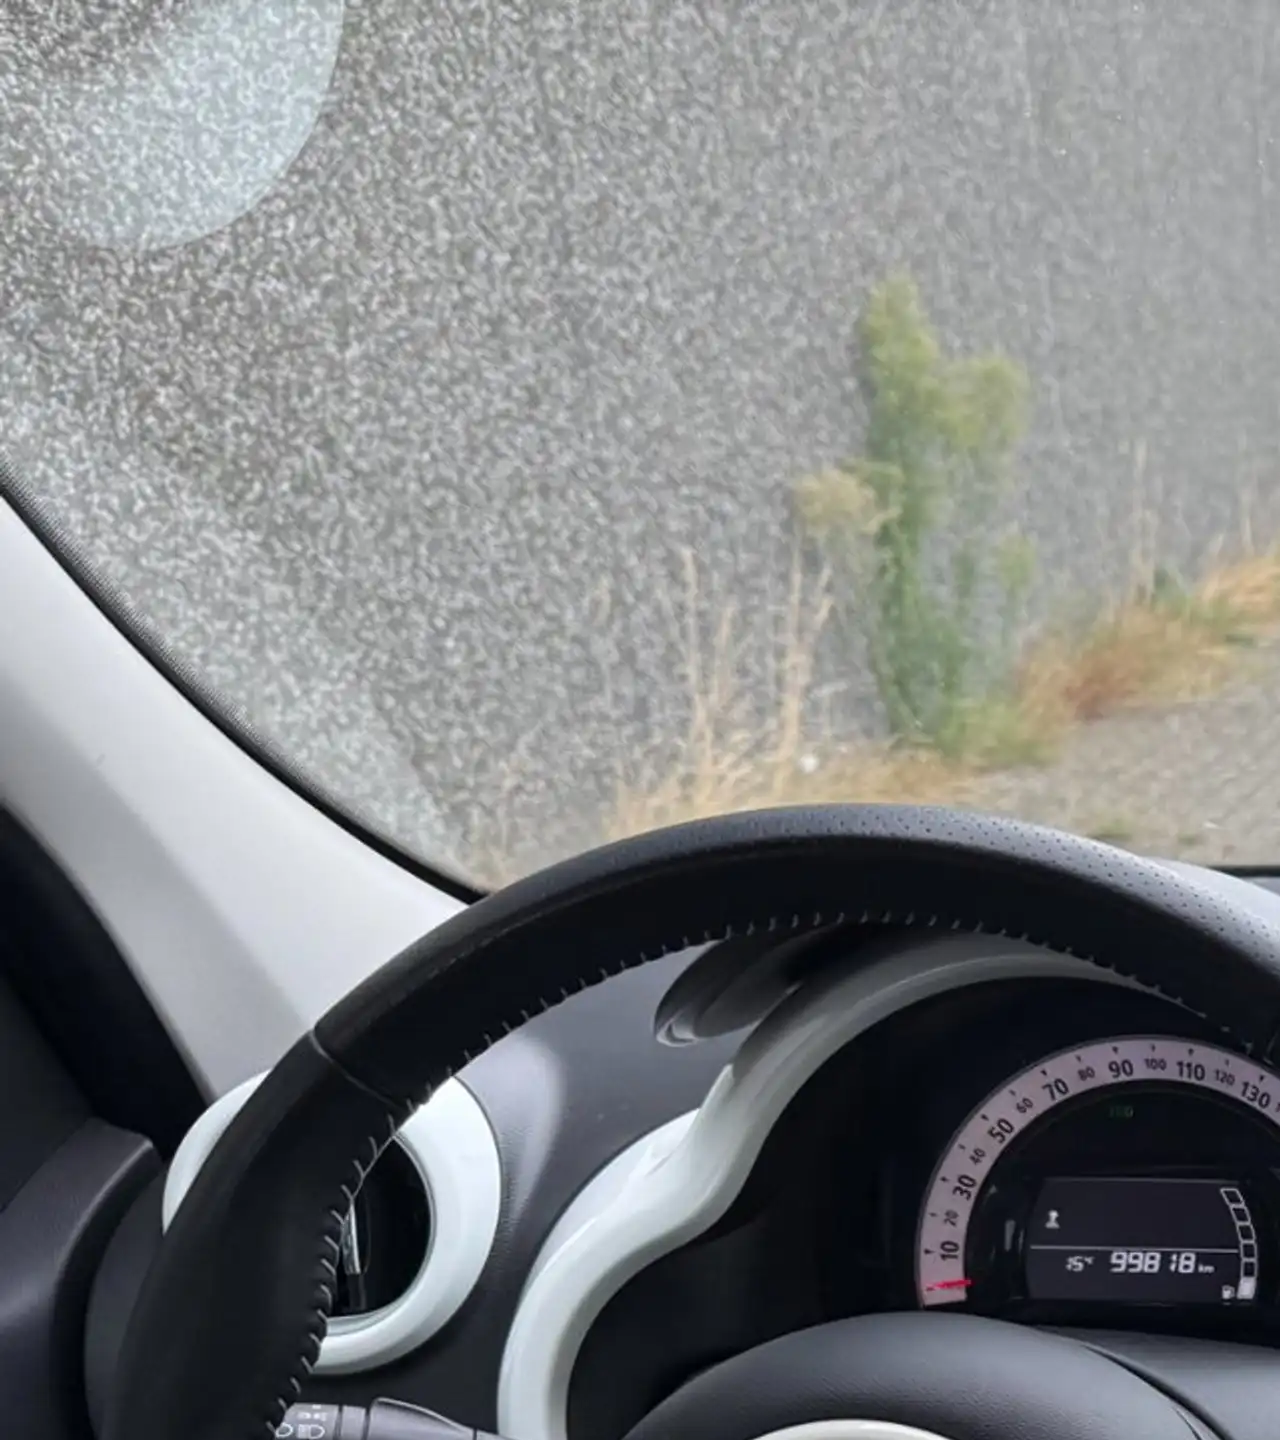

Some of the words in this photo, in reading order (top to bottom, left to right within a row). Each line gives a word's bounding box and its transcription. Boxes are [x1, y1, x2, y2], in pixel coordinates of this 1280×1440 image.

[1077, 1066, 1096, 1081] 80
[1108, 1059, 1134, 1079] 90
[1144, 1058, 1167, 1071] 100
[1177, 1060, 1206, 1081] 110
[1214, 1069, 1236, 1086] 120
[1042, 1078, 1070, 1102] 70
[1241, 1081, 1271, 1109] 130
[1016, 1097, 1034, 1114] 60
[987, 1118, 1014, 1144] 50
[969, 1148, 987, 1166] 40
[953, 1174, 977, 1201] 30
[944, 1209, 960, 1227] 20
[940, 1240, 960, 1261] 10
[1109, 1251, 1197, 1274] 99818
